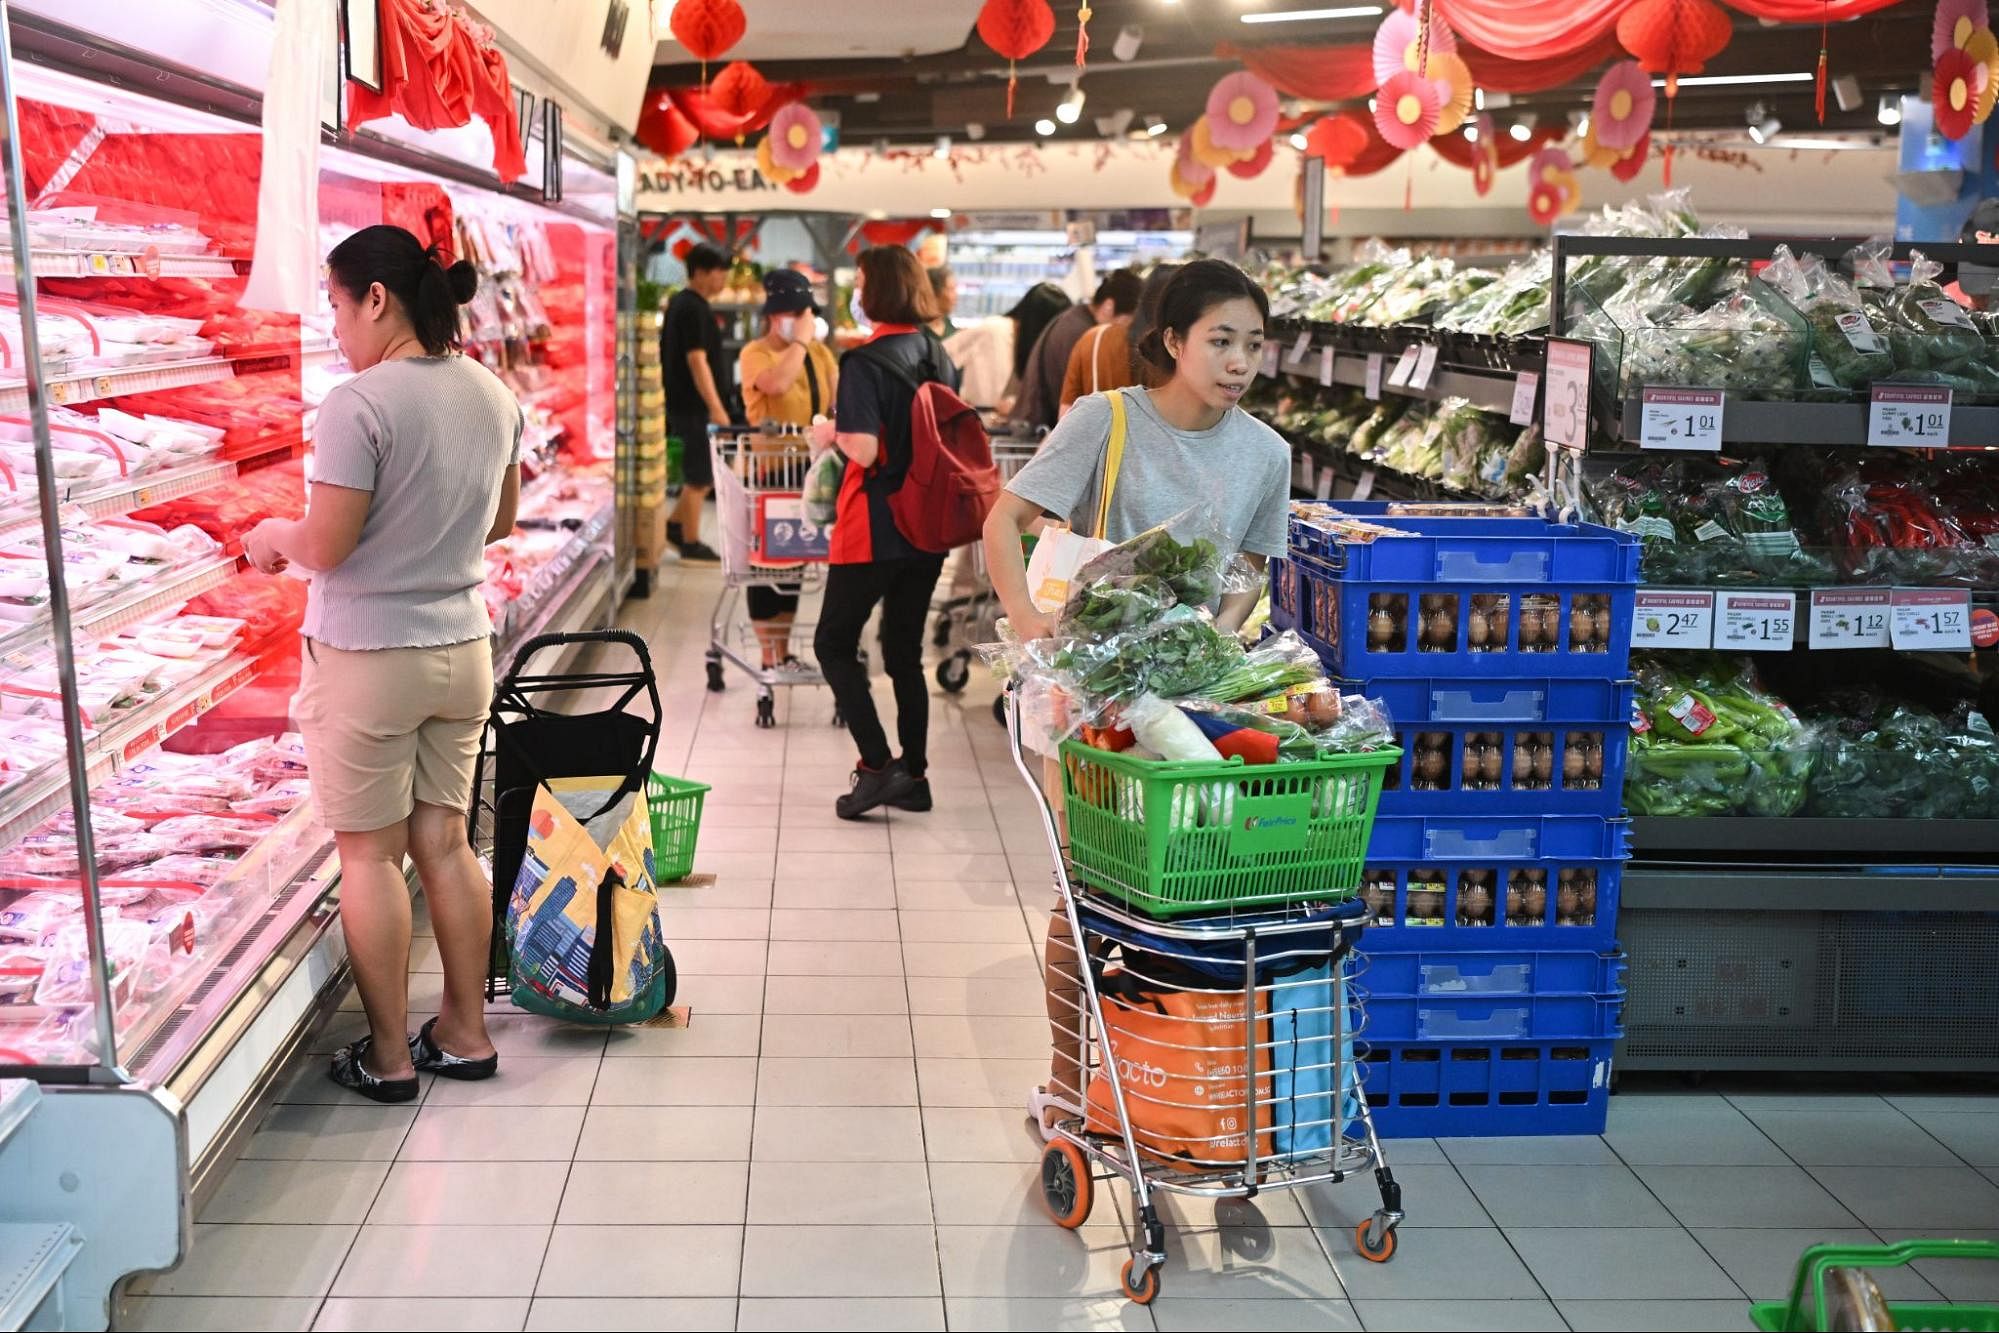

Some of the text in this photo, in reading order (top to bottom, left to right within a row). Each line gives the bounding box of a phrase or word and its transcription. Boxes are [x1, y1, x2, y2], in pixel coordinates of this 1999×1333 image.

[637, 169, 777, 193] ADY-TO-EA
[1684, 415, 1695, 437] 1
[1699, 415, 1716, 428] 01
[1914, 413, 1943, 436] 1 01
[1666, 613, 1680, 635] 2
[1681, 613, 1698, 626] 47
[1760, 618, 1789, 640] 1 55
[1854, 614, 1883, 636] 1 12
[1931, 611, 1960, 634] 1 57
